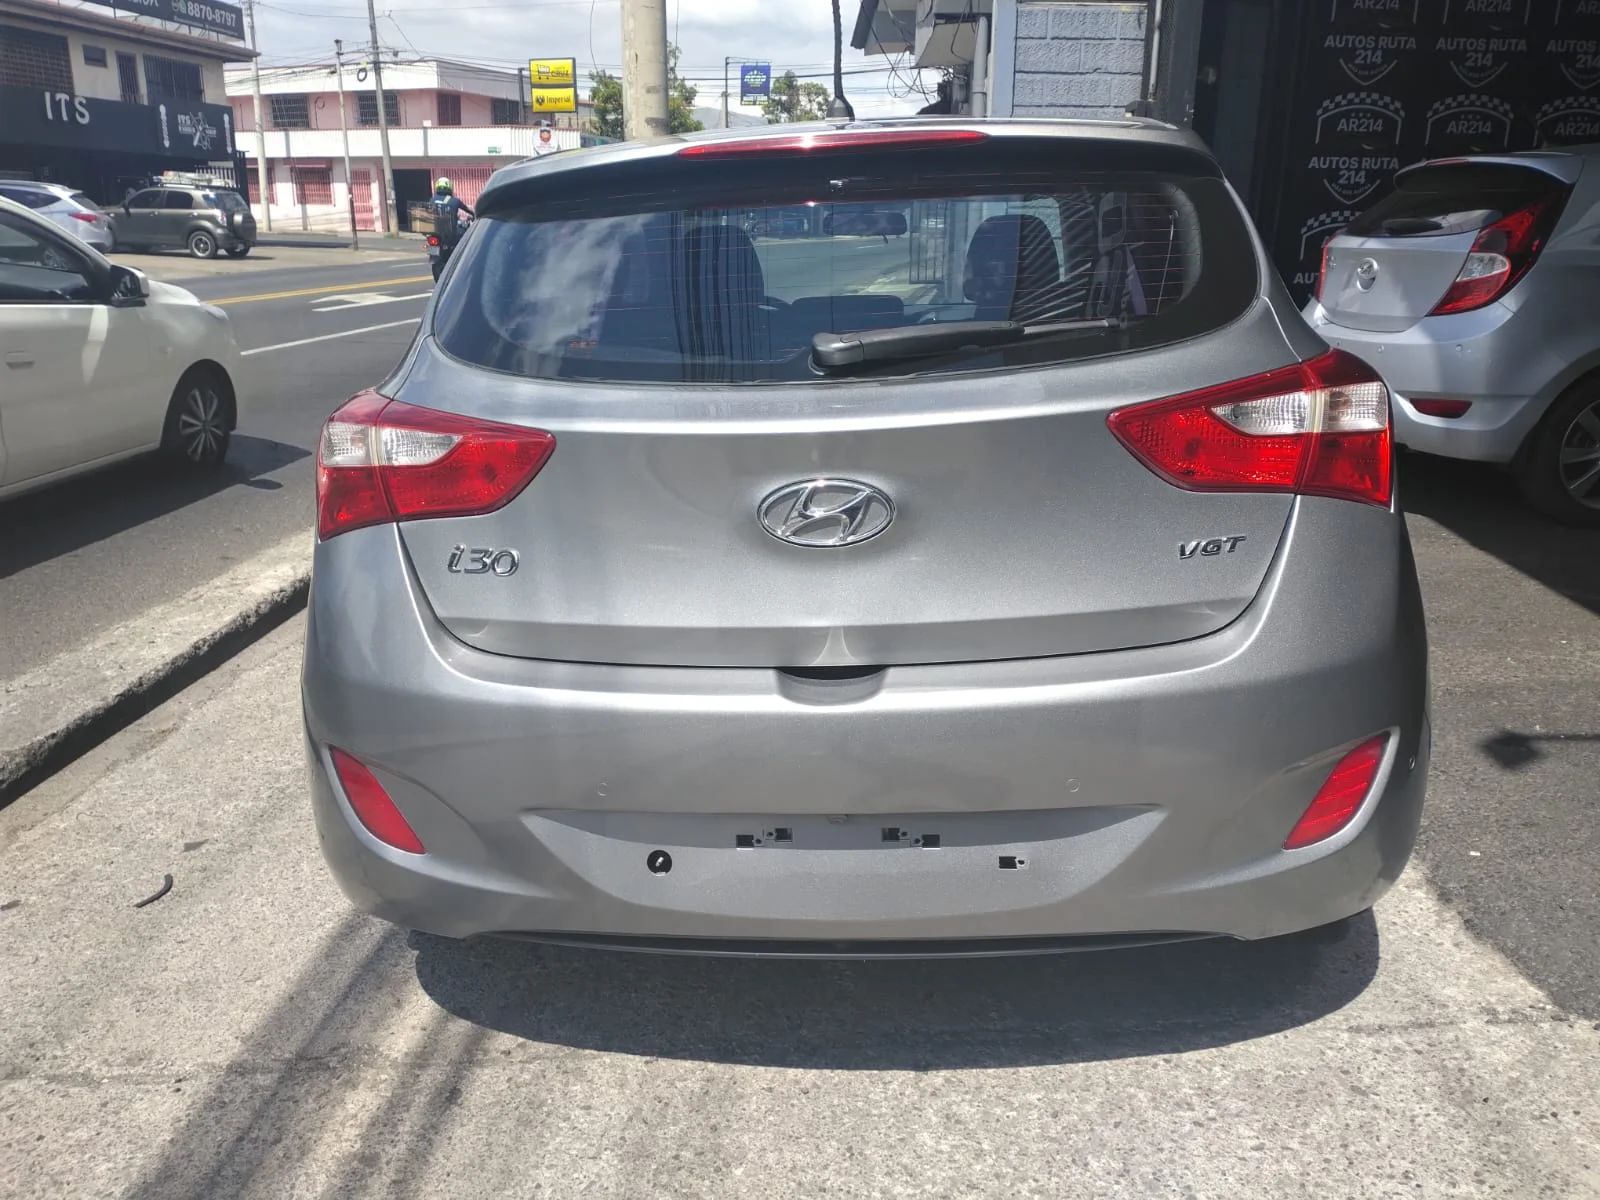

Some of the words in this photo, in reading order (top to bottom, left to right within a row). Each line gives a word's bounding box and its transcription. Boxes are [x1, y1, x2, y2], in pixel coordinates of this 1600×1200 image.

[1464, 0, 1512, 13] AR214
[187, 1, 237, 28] 8870-8797
[1324, 35, 1375, 49] AUTOS
[1378, 36, 1417, 50] RUTA
[1435, 37, 1487, 52] AUTOS
[1488, 38, 1528, 53] RUTA
[1546, 39, 1597, 54] AUTOS
[1354, 49, 1383, 65] 214
[1465, 52, 1493, 67] 214
[44, 91, 90, 125] ITS
[1336, 118, 1384, 132] AR214
[1446, 120, 1492, 135] AR214
[1308, 156, 1359, 170] AUTOS
[1361, 157, 1399, 170] RUTA
[1337, 170, 1367, 185] 214
[1178, 534, 1248, 560] VGT
[447, 544, 521, 578] i30
